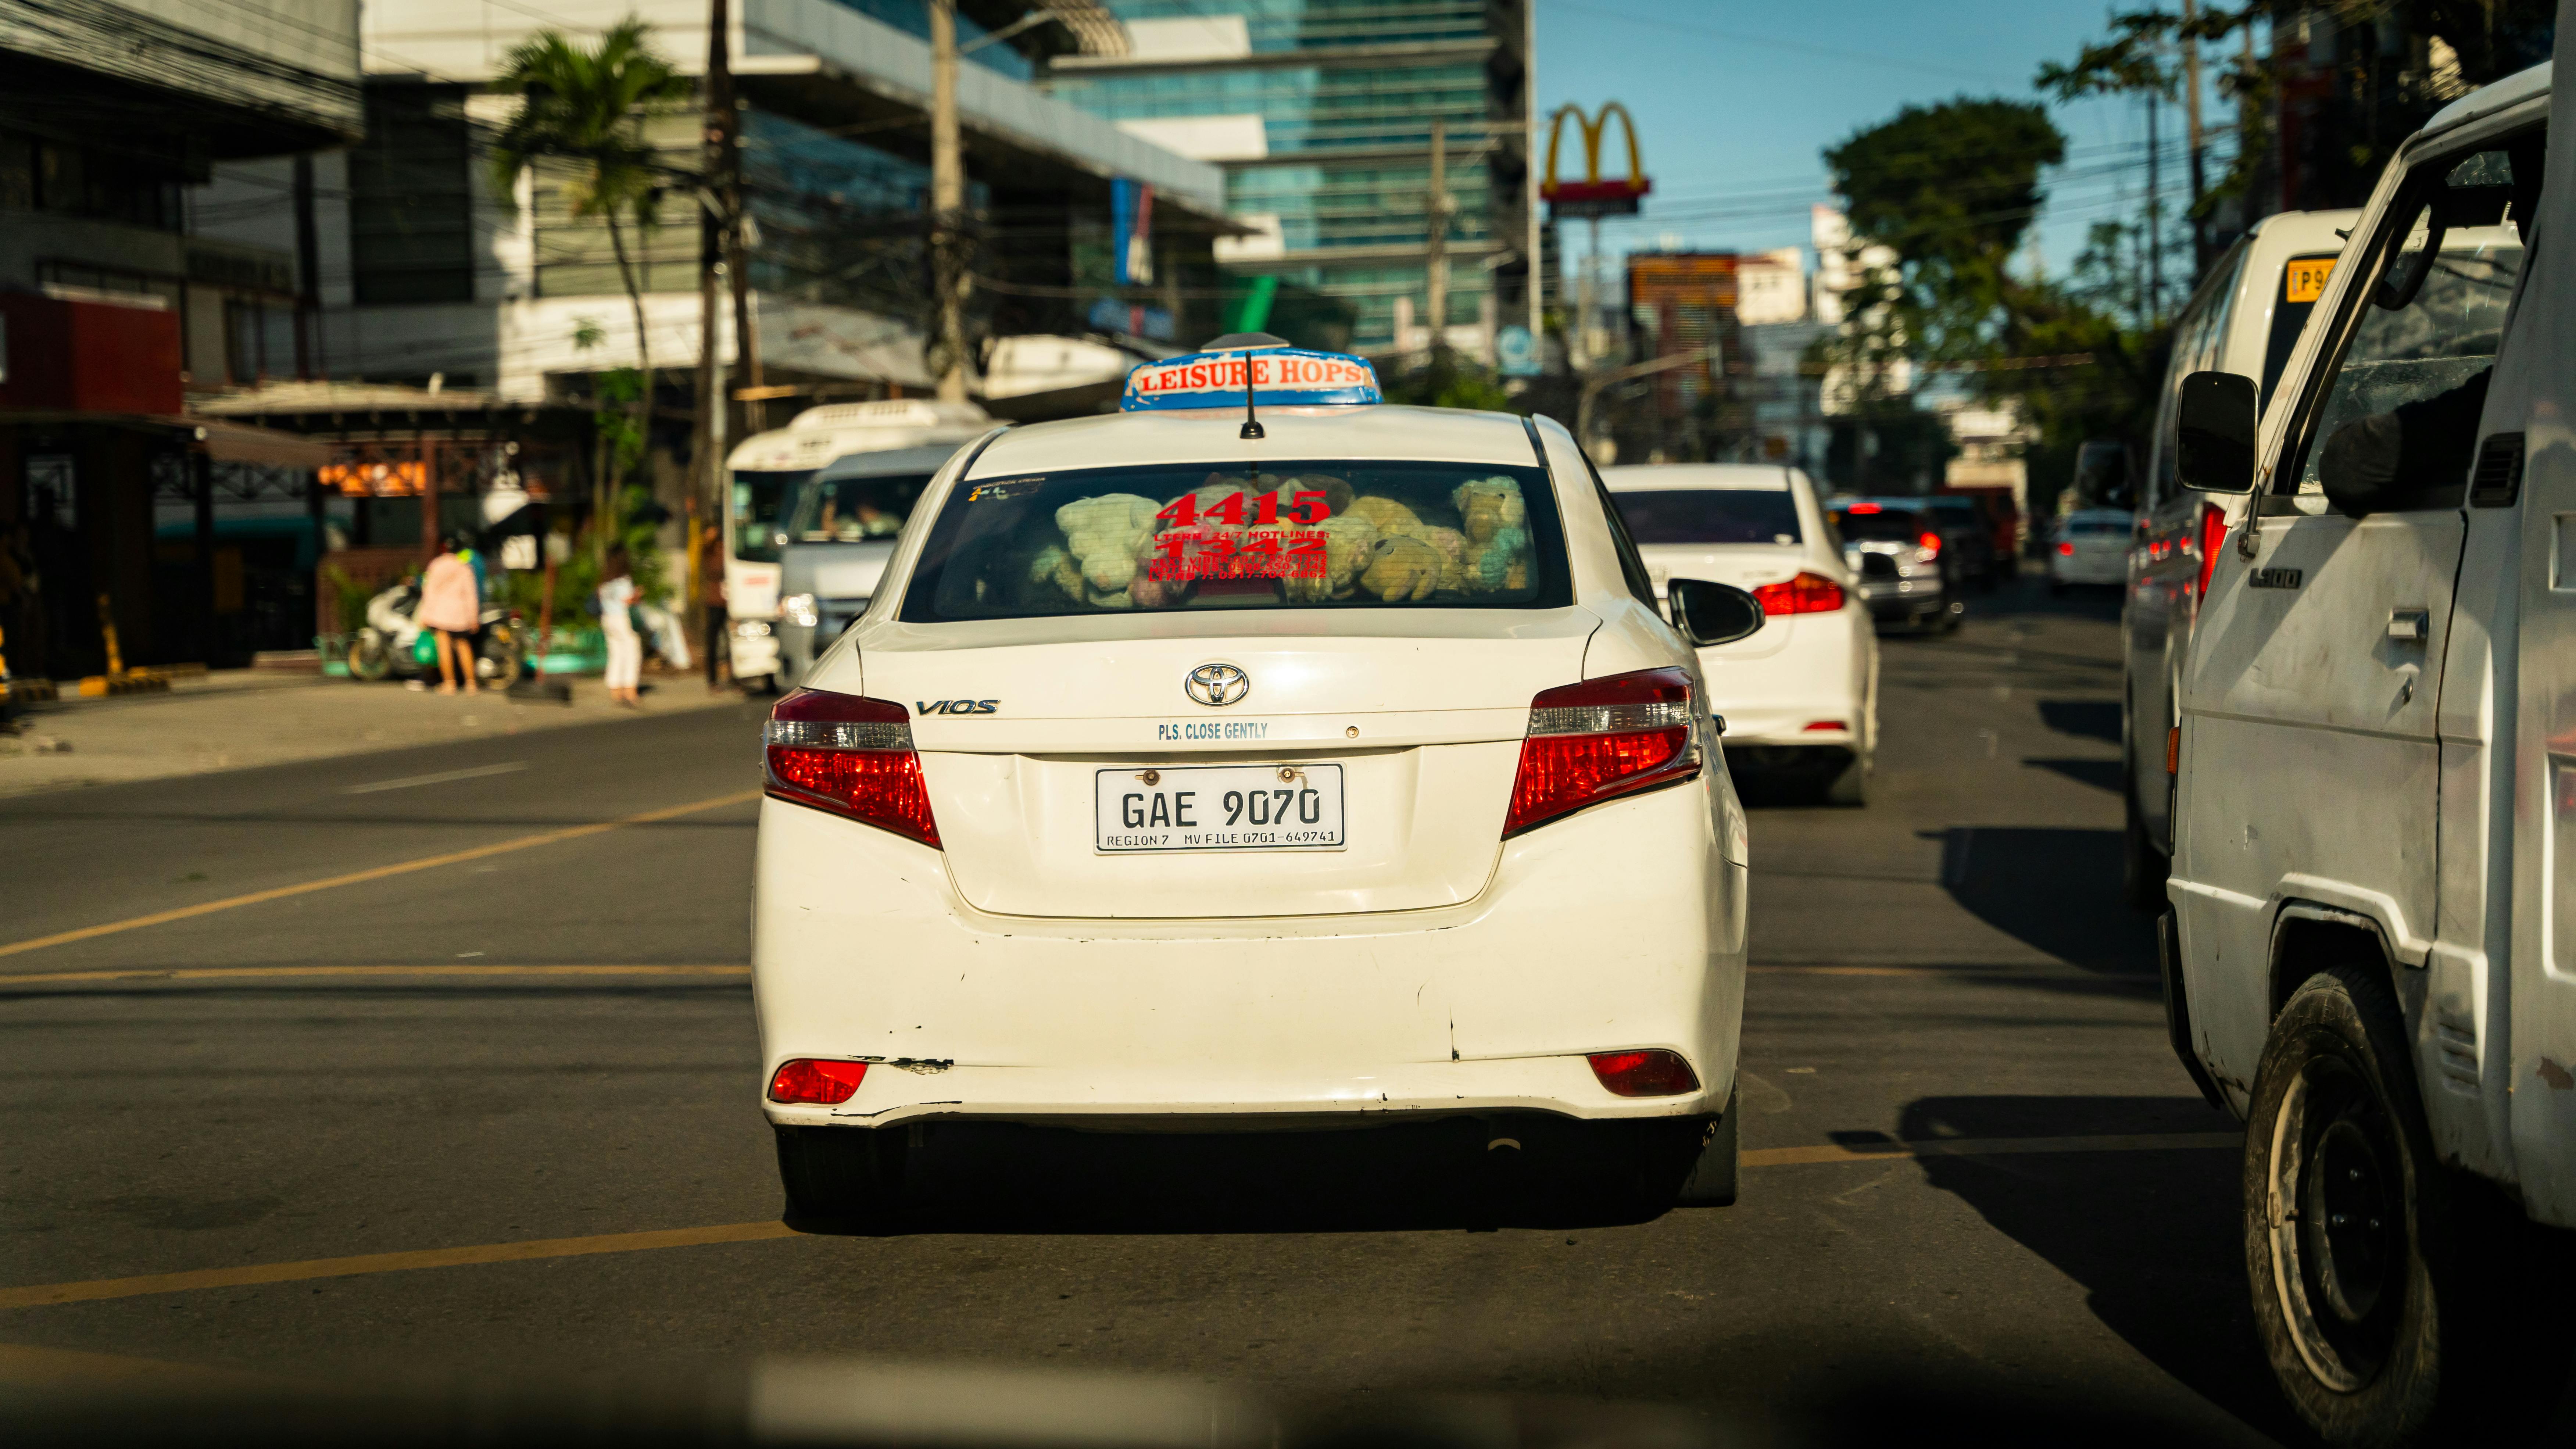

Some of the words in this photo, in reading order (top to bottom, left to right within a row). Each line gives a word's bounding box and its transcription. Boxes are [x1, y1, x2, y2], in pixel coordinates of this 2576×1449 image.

[1142, 360, 1269, 391] LEISURE
[1280, 360, 1361, 383] HOPS
[1156, 491, 1331, 527] 4415
[1154, 533, 1202, 541] LTFRB
[1155, 538, 1327, 557] 1342
[1149, 565, 1223, 574] HOTLINES:
[1151, 557, 1184, 566] TEXT
[1148, 572, 1195, 582] LTFRB
[1218, 570, 1327, 580] 0917-704-6862
[2249, 568, 2303, 588] L300
[916, 700, 1001, 715] VIOS
[1159, 724, 1181, 740] PLS.
[1186, 723, 1221, 739] CLOSE
[1225, 723, 1268, 739] GENTLY
[1123, 792, 1197, 829] GAE
[1223, 789, 1320, 826] 9070
[1107, 836, 1157, 846] REGION
[1162, 835, 1169, 845] 7
[1184, 834, 1201, 844] MV
[1206, 833, 1238, 844] FILE
[1243, 831, 1335, 843] 0701-649741
